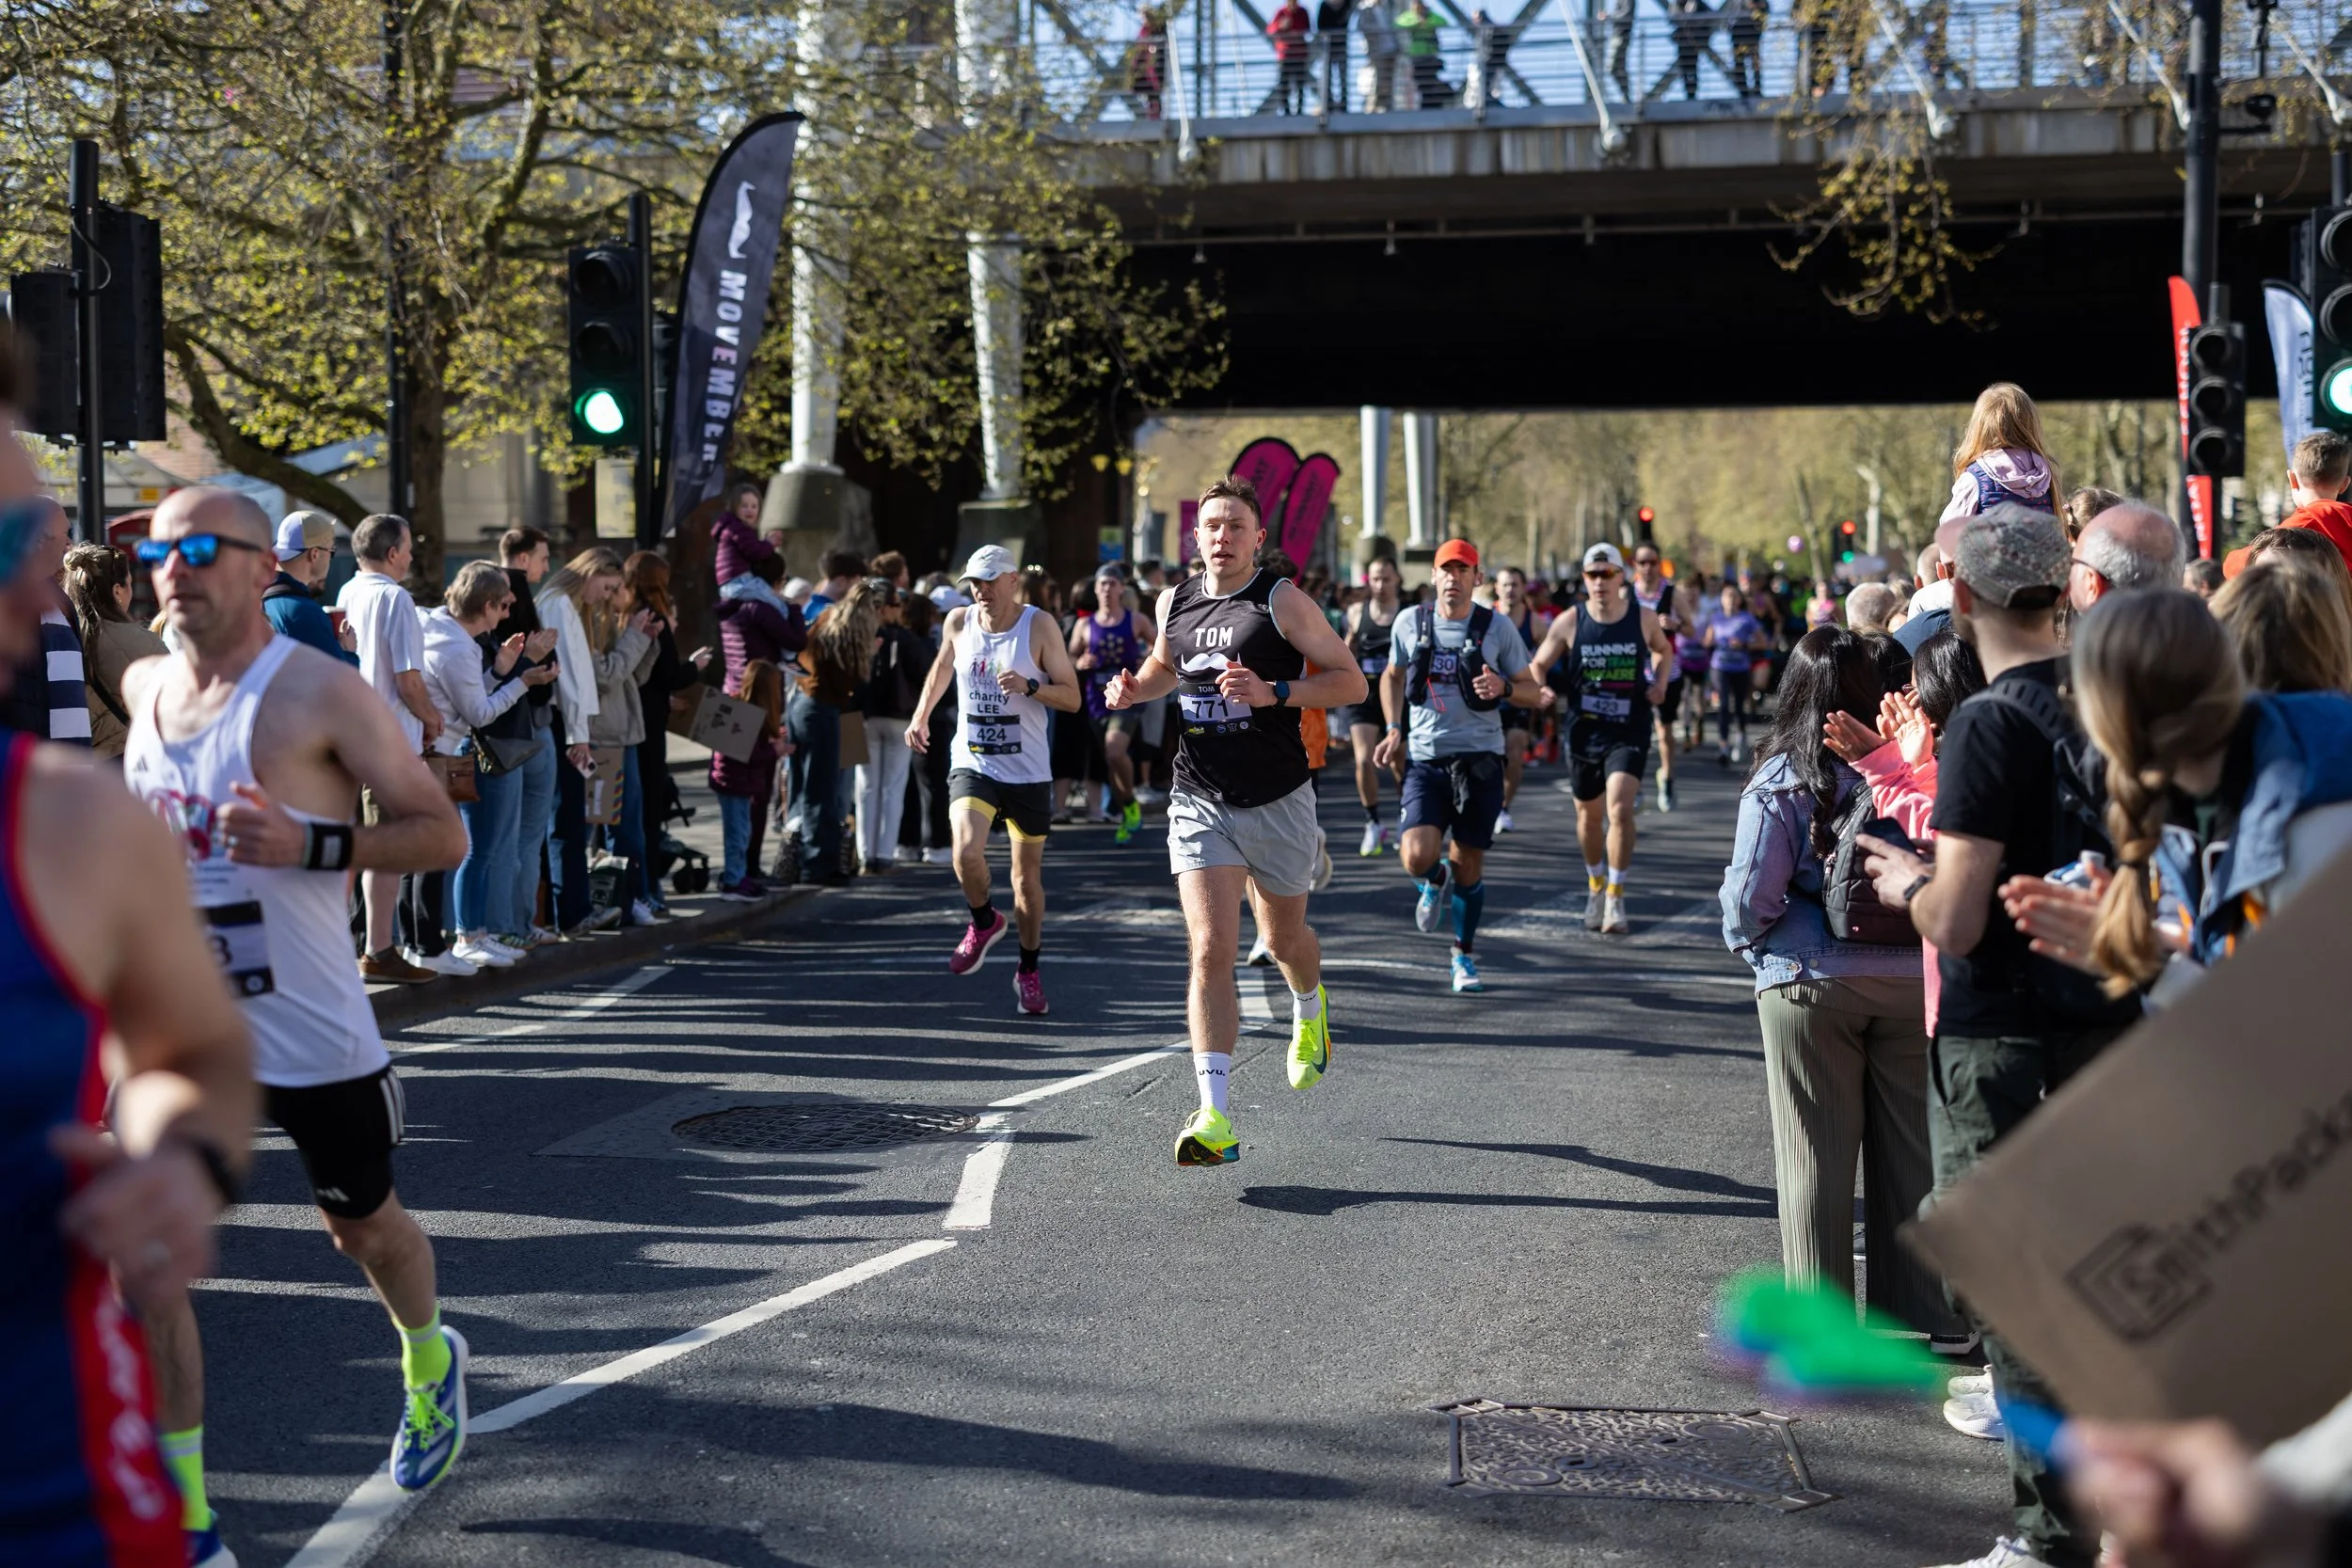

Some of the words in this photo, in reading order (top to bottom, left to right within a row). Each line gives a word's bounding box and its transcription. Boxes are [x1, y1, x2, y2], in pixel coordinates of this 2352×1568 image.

[1195, 626, 1233, 647] TOM
[1581, 642, 1637, 657] RUNNING
[1198, 685, 1216, 693] TOM
[969, 690, 1009, 705] charity
[977, 704, 999, 714] LEE
[1191, 699, 1229, 720] 771
[1592, 700, 1618, 714] 423
[977, 727, 1007, 742] 424
